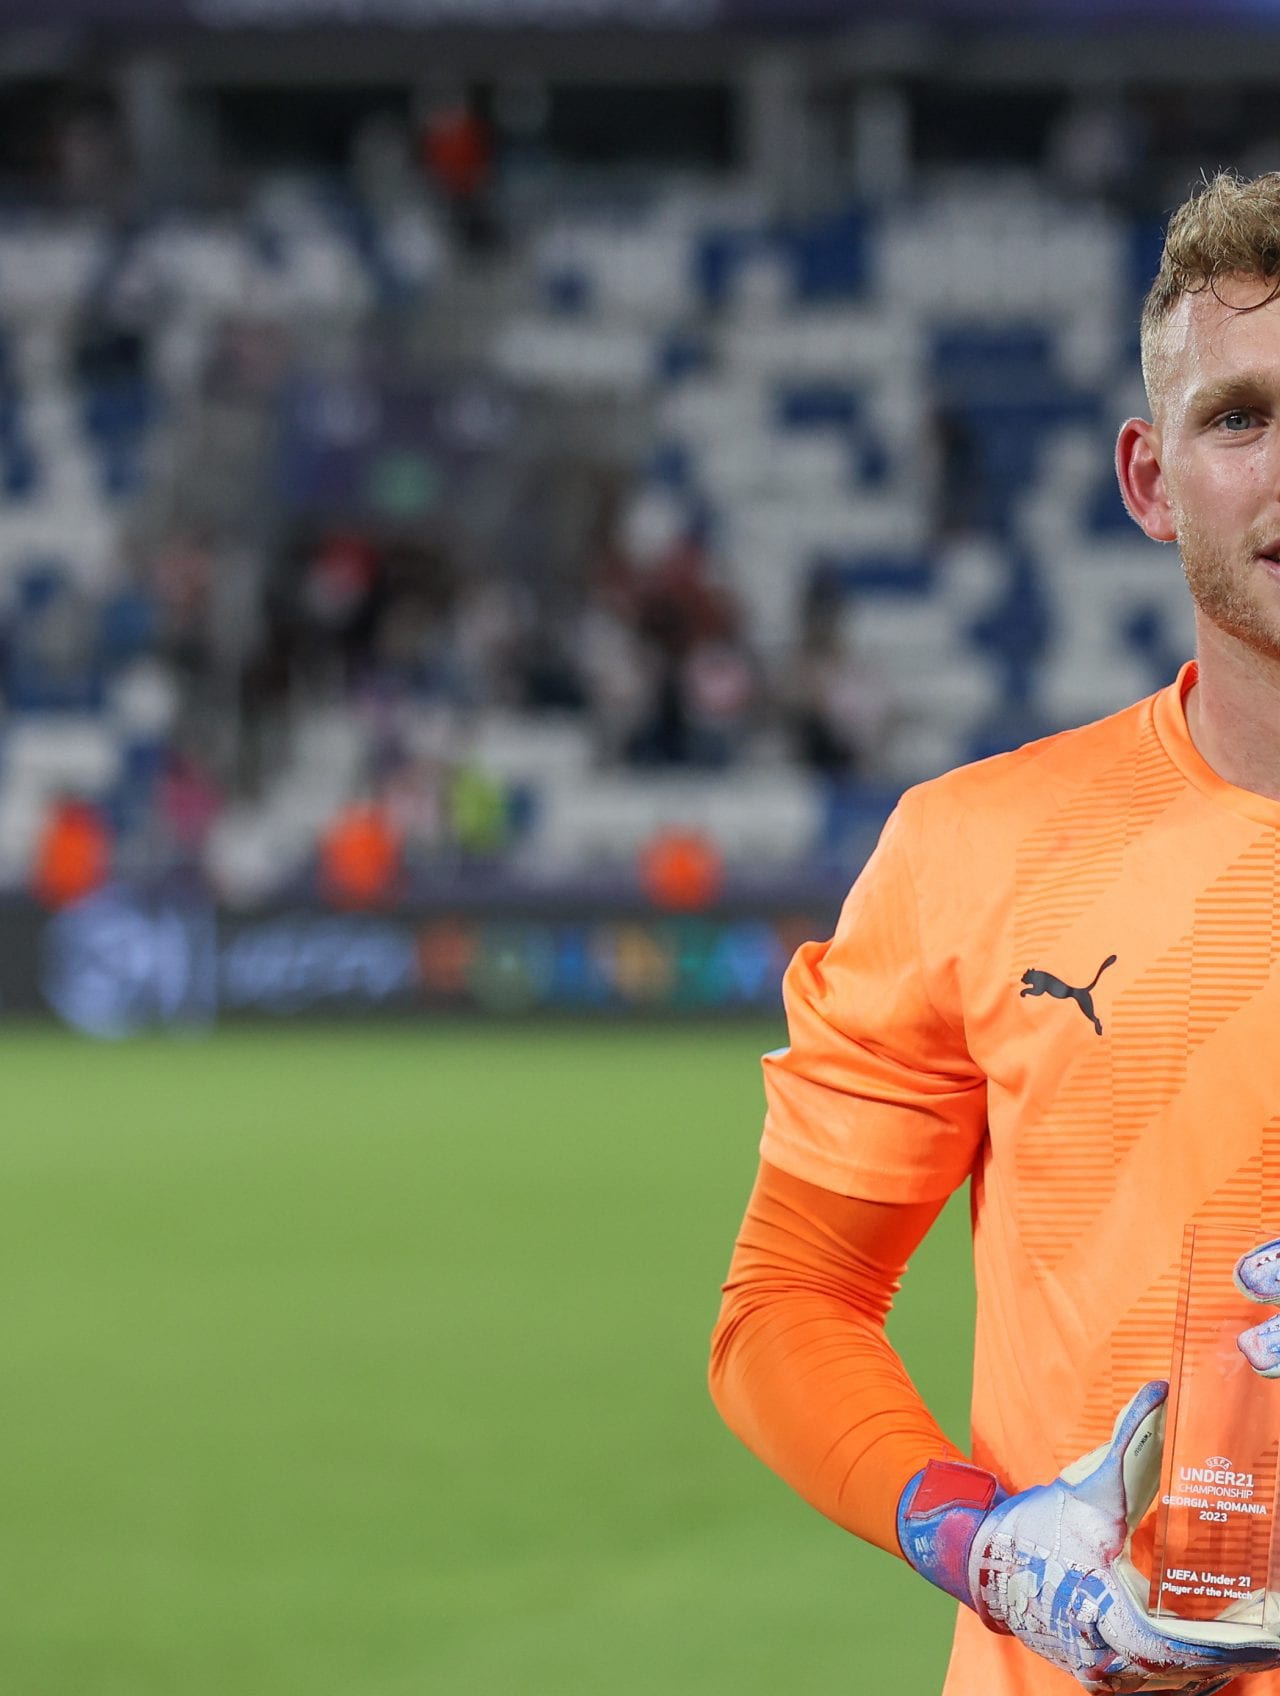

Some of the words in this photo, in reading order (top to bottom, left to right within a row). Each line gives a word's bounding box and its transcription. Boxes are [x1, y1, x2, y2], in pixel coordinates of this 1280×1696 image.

[1206, 1458, 1231, 1470] UEFA
[1180, 1467, 1254, 1487] UNDER21
[1179, 1483, 1253, 1499] CHAMPIONSHIP
[1162, 1495, 1209, 1509] GEORGIA
[1216, 1500, 1267, 1515] ROMANIA
[1199, 1510, 1228, 1522] 2023
[1166, 1568, 1198, 1582] UEFA
[1201, 1572, 1236, 1586] Under
[1238, 1576, 1251, 1587] 21
[1161, 1582, 1192, 1595] Player
[1193, 1586, 1205, 1595] of
[1206, 1587, 1222, 1597] the
[1223, 1589, 1252, 1600] Match
